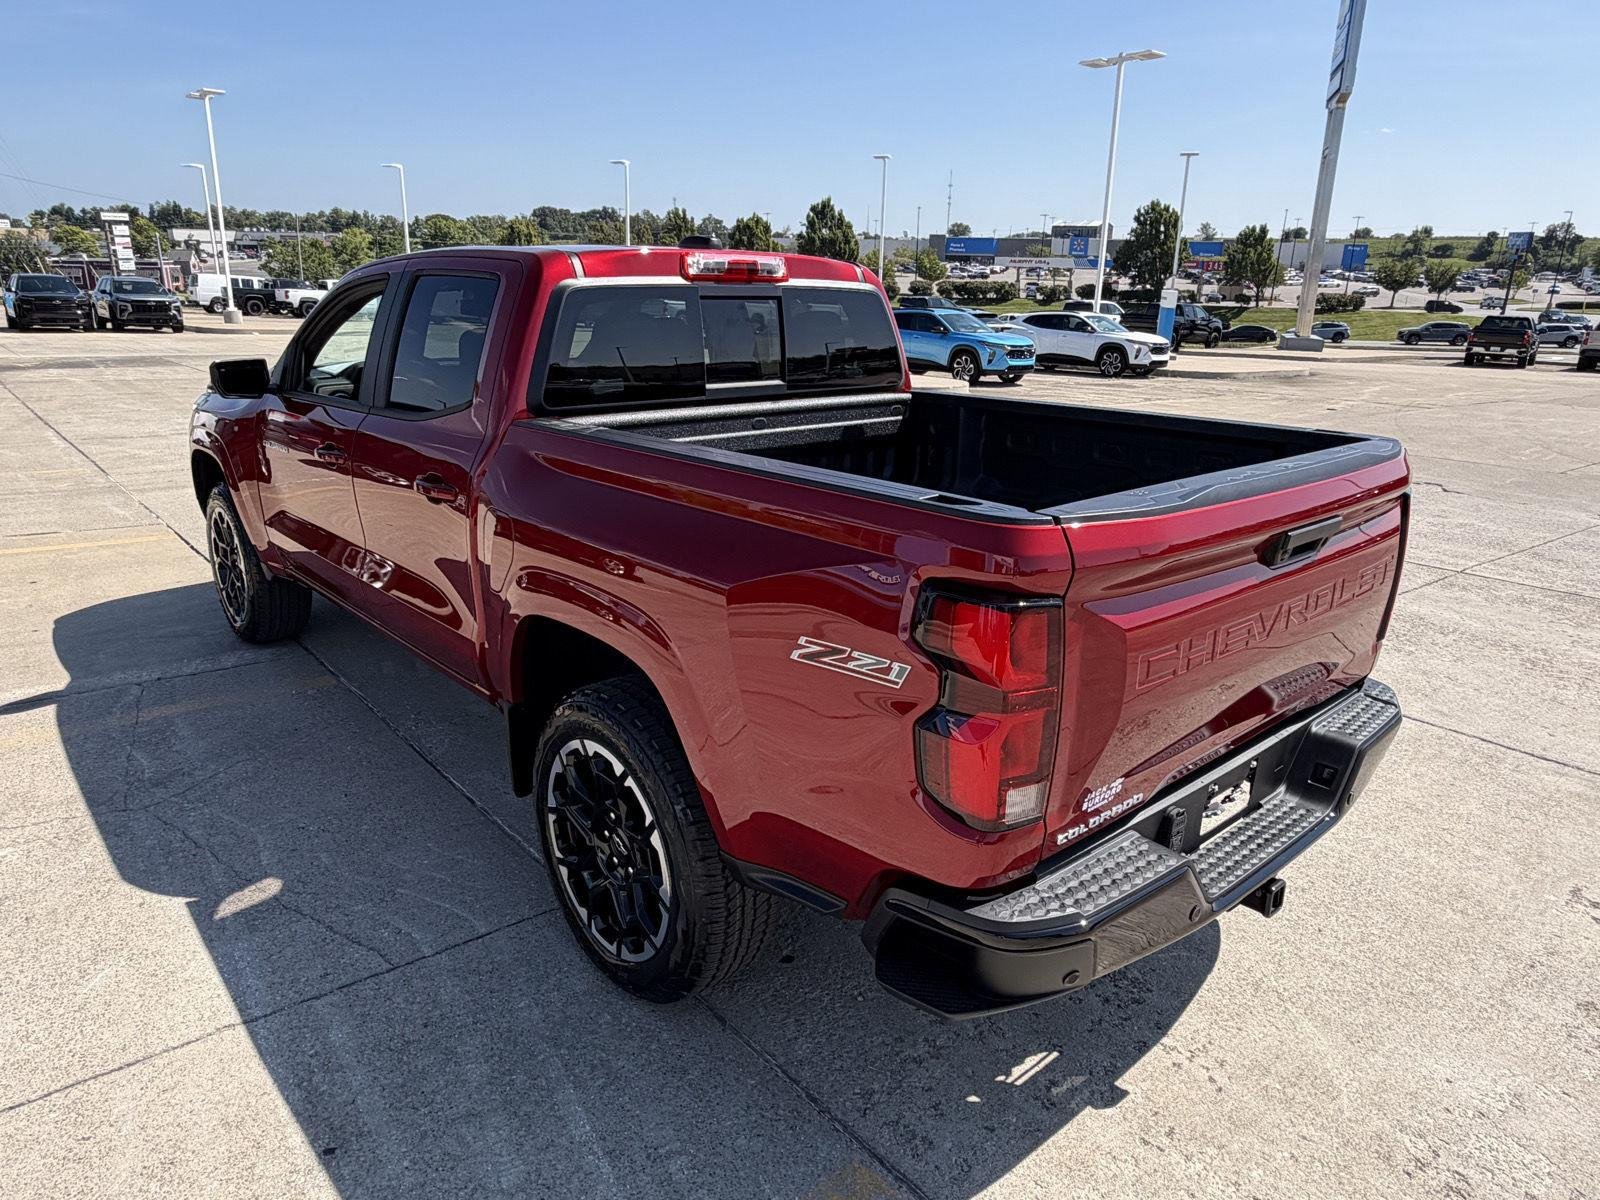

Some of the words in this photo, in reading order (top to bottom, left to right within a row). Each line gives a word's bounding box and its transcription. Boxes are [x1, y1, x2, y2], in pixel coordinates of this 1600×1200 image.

[1136, 555, 1395, 690] CHEVROLET
[790, 635, 912, 689] Z71
[1057, 793, 1144, 846] COLORADO
[1082, 784, 1122, 811] BURFORD
[1084, 784, 1108, 802] JACK
